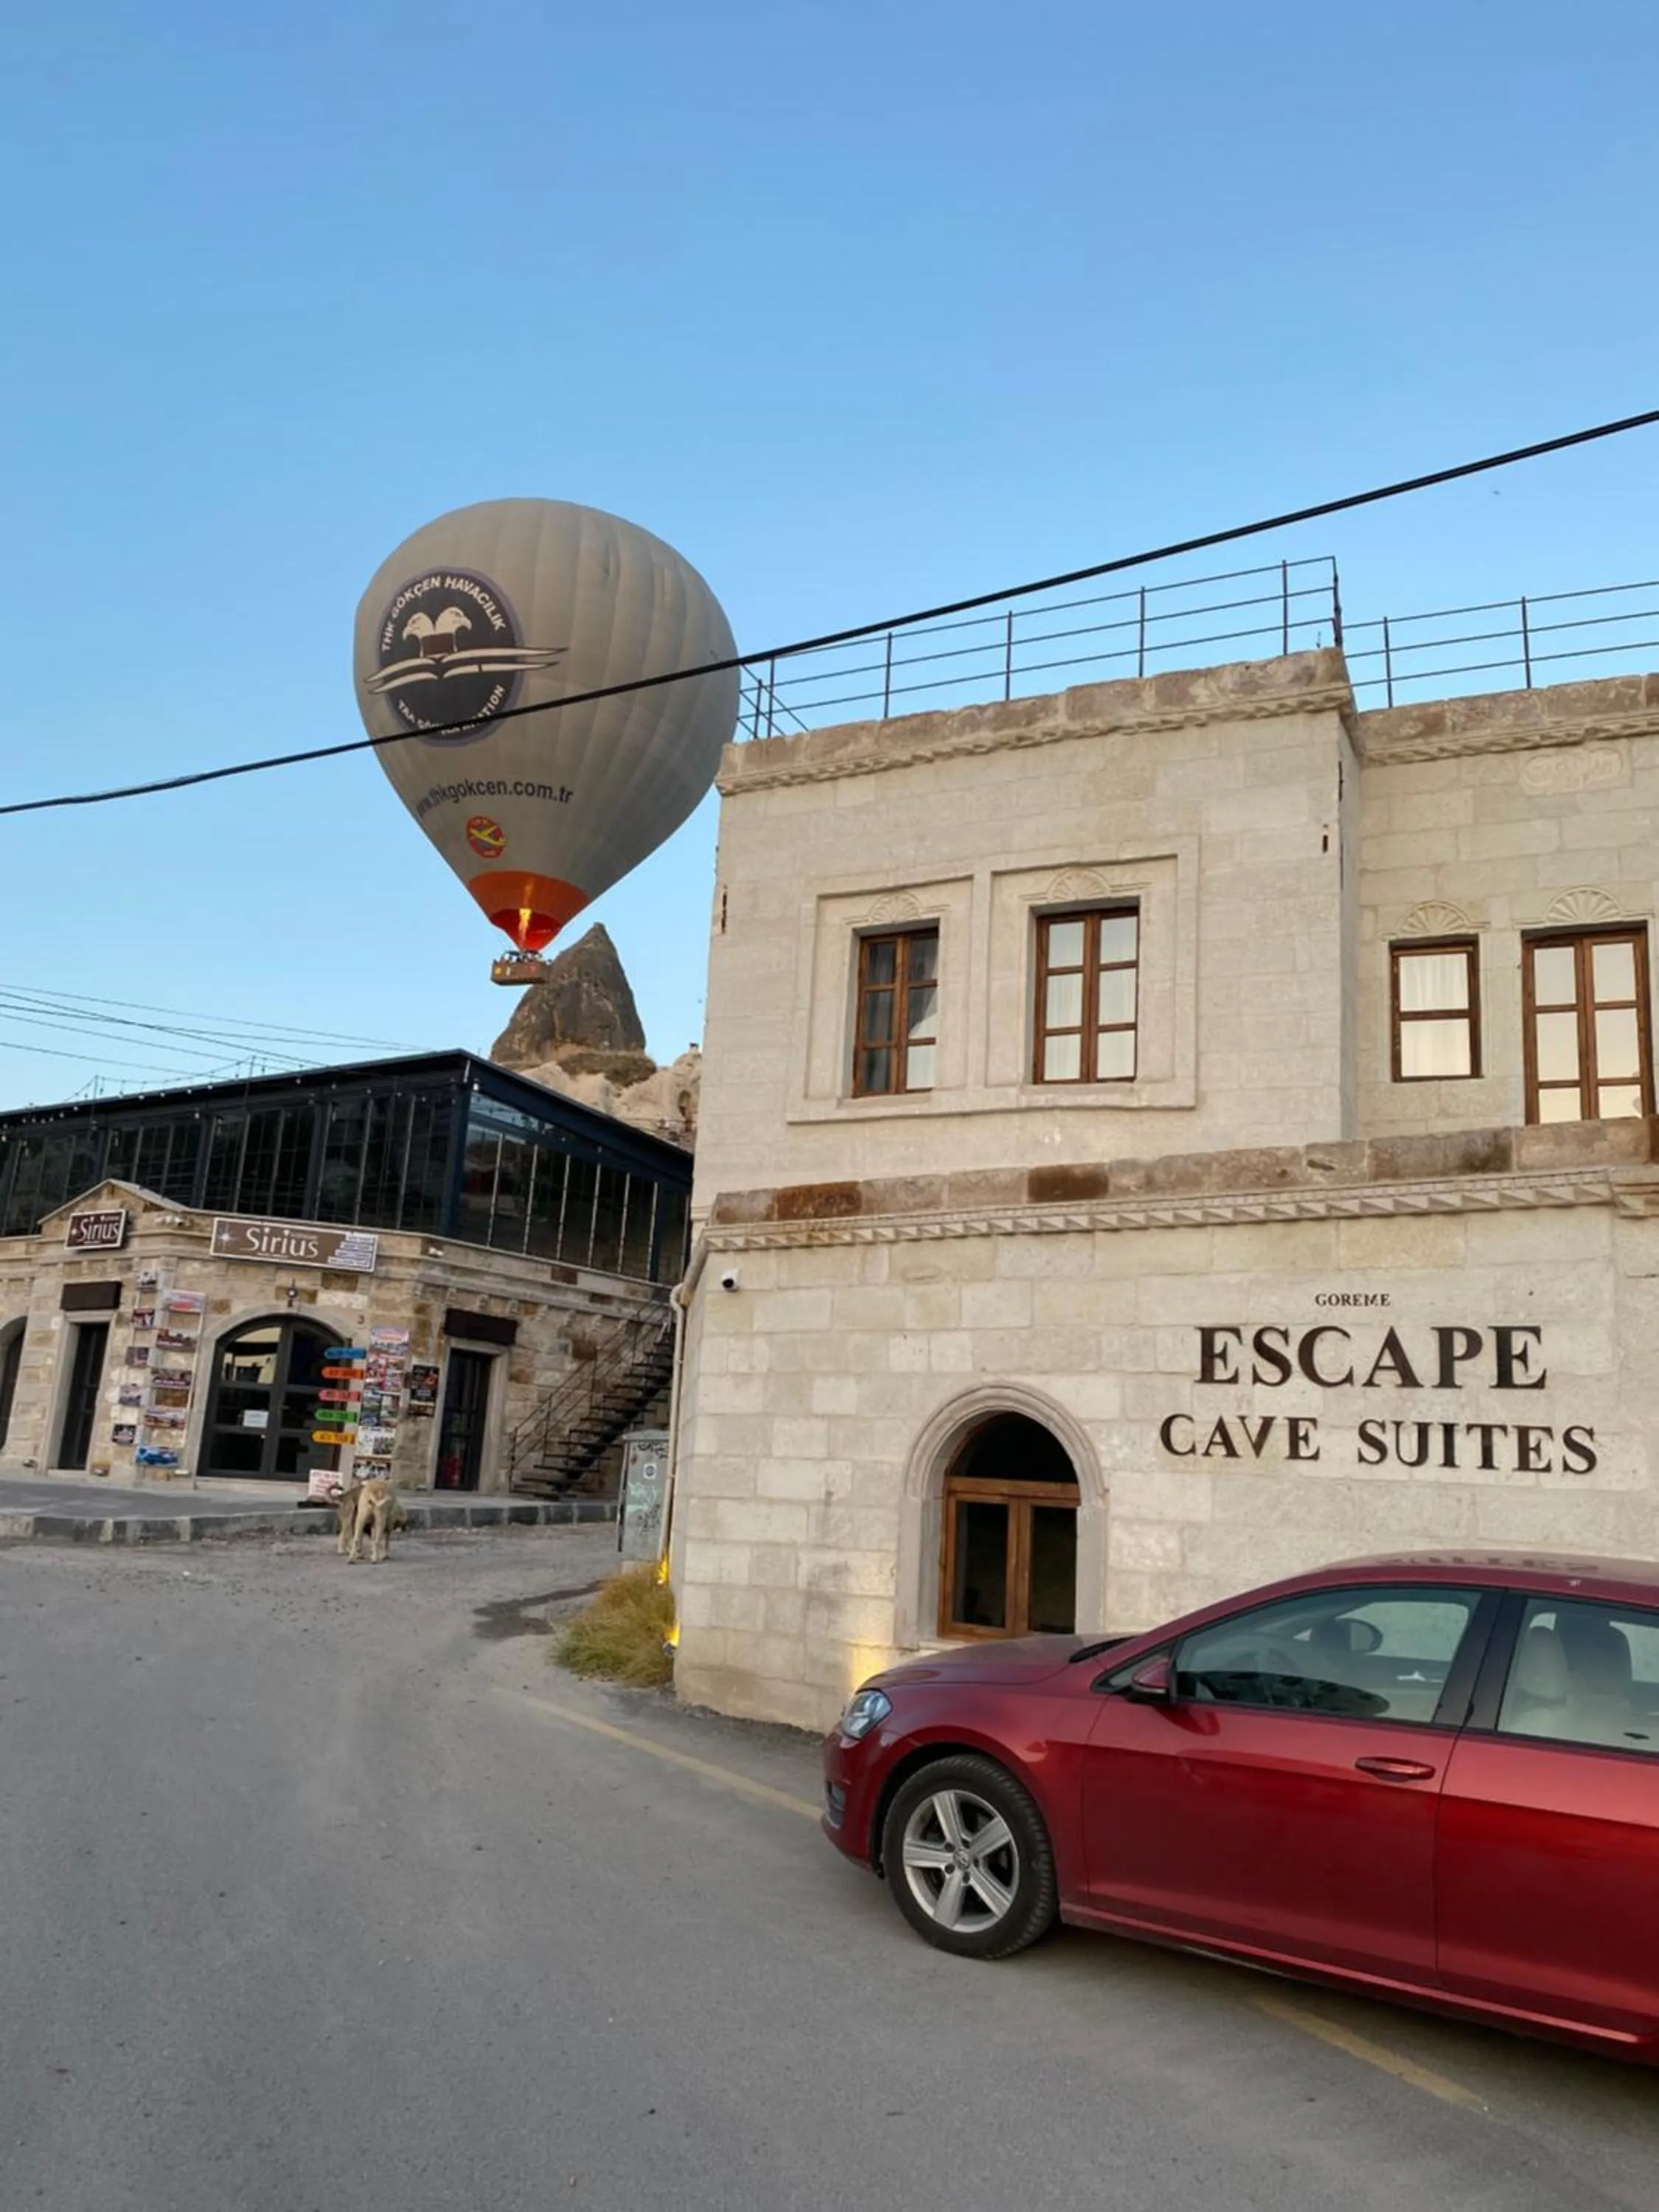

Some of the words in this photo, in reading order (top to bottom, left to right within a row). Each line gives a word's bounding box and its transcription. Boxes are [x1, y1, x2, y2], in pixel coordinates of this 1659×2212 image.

[382, 623, 394, 653] THK
[77, 1215, 119, 1242] Sirius
[239, 1227, 319, 1259] Sirius
[1315, 1294, 1391, 1307] GOREME
[1194, 1326, 1548, 1390] ESCAPE
[1160, 1413, 1321, 1461] CAVE
[1357, 1419, 1598, 1475] SUITES
